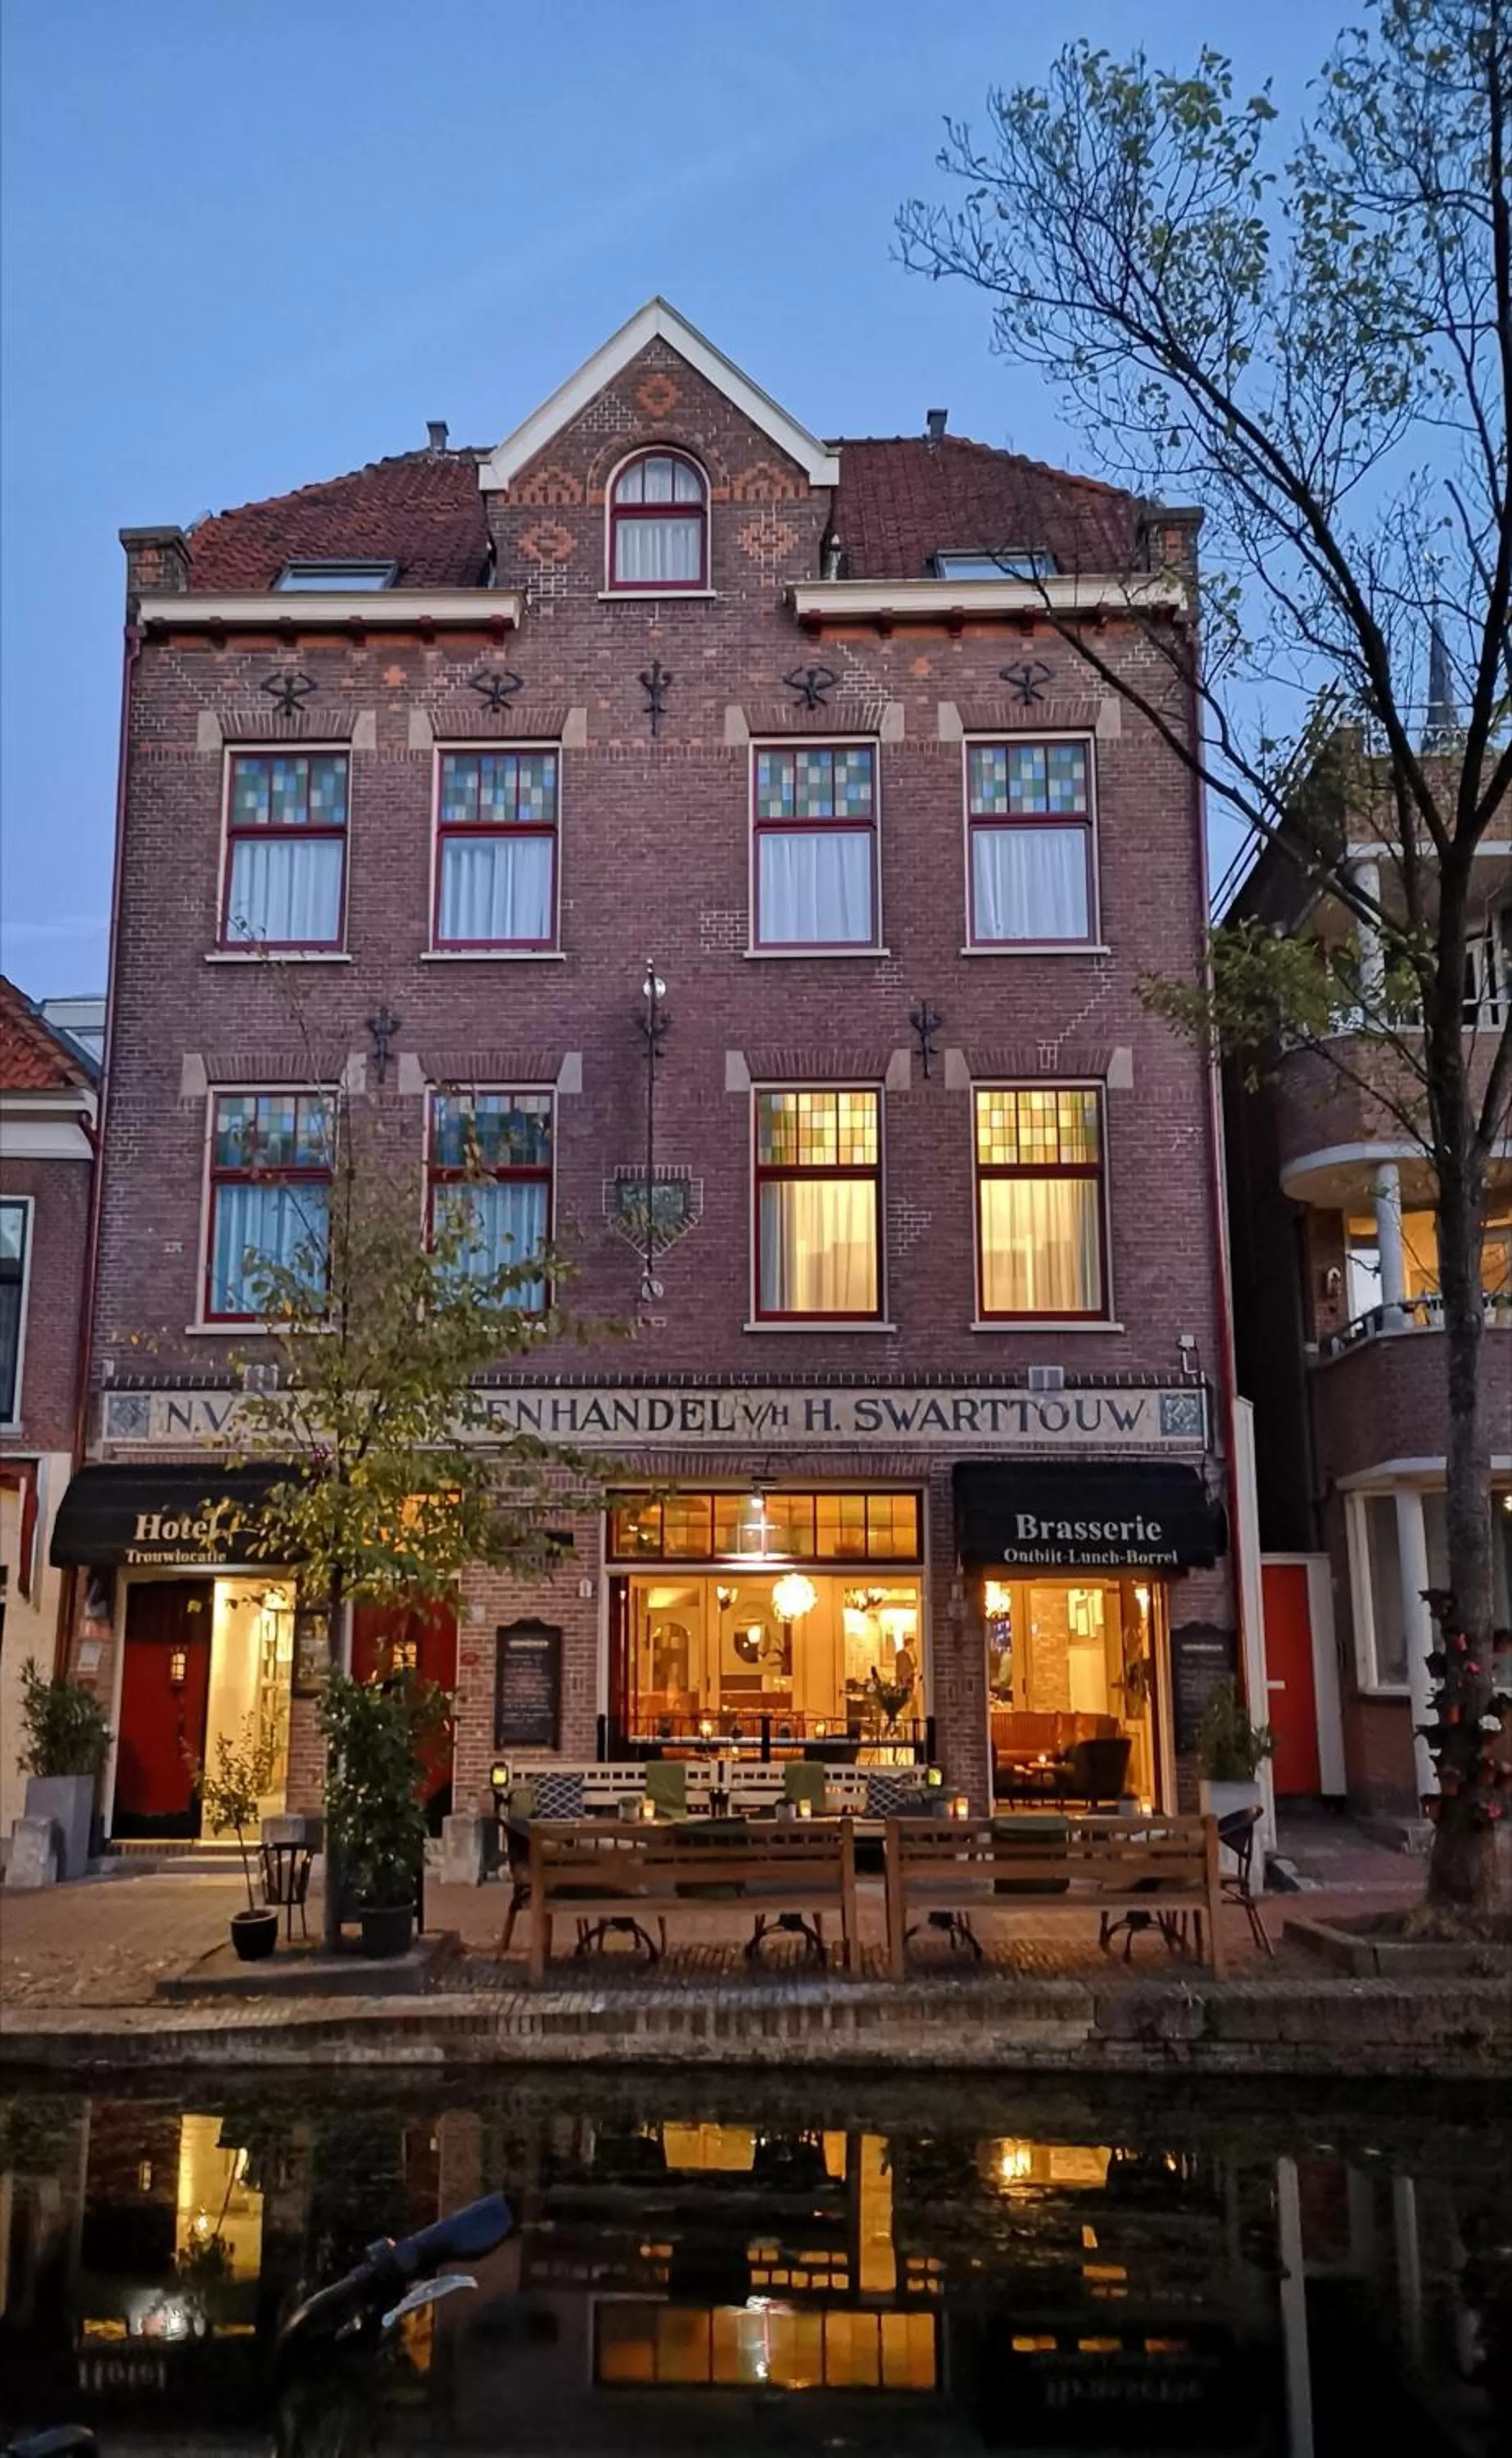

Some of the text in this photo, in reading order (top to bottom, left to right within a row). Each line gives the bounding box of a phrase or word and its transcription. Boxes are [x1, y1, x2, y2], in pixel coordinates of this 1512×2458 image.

[166, 1399, 234, 1434] N.V.
[804, 1398, 841, 1431] H.
[853, 1398, 1146, 1433] SWARTTOUW
[133, 1512, 218, 1541] Hotel
[1015, 1513, 1163, 1542] Brasserie
[124, 1547, 228, 1564] Trouwlocatie
